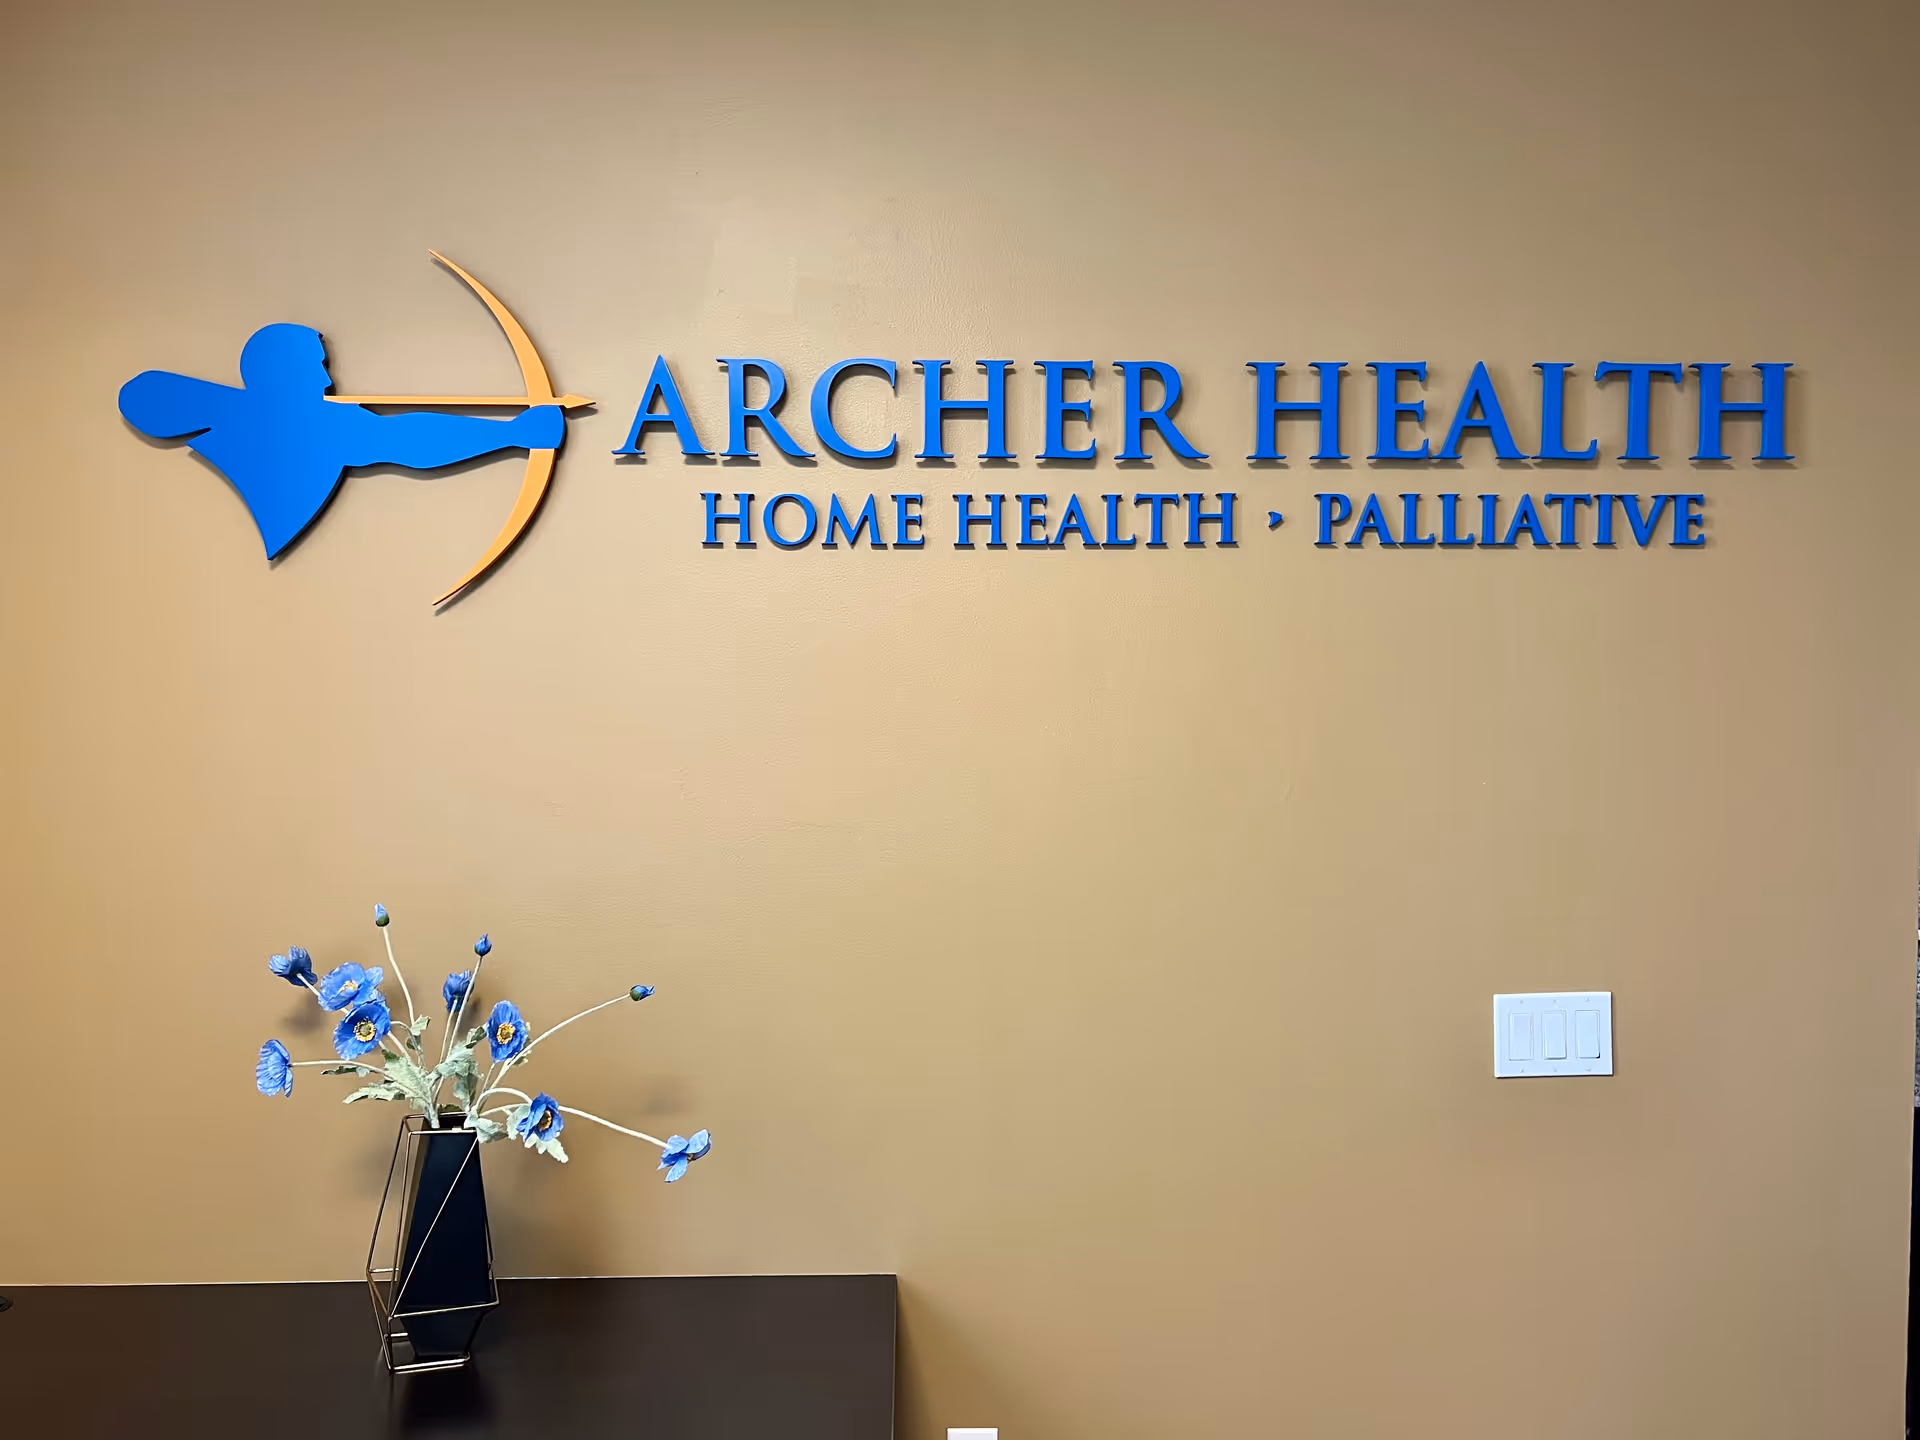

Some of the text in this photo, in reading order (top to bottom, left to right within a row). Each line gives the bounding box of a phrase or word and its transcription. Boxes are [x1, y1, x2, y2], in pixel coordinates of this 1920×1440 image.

[611, 354, 1796, 462] ARCHER HEALTH
[700, 492, 1706, 547] HOME HEALTH PALLIATIVE
